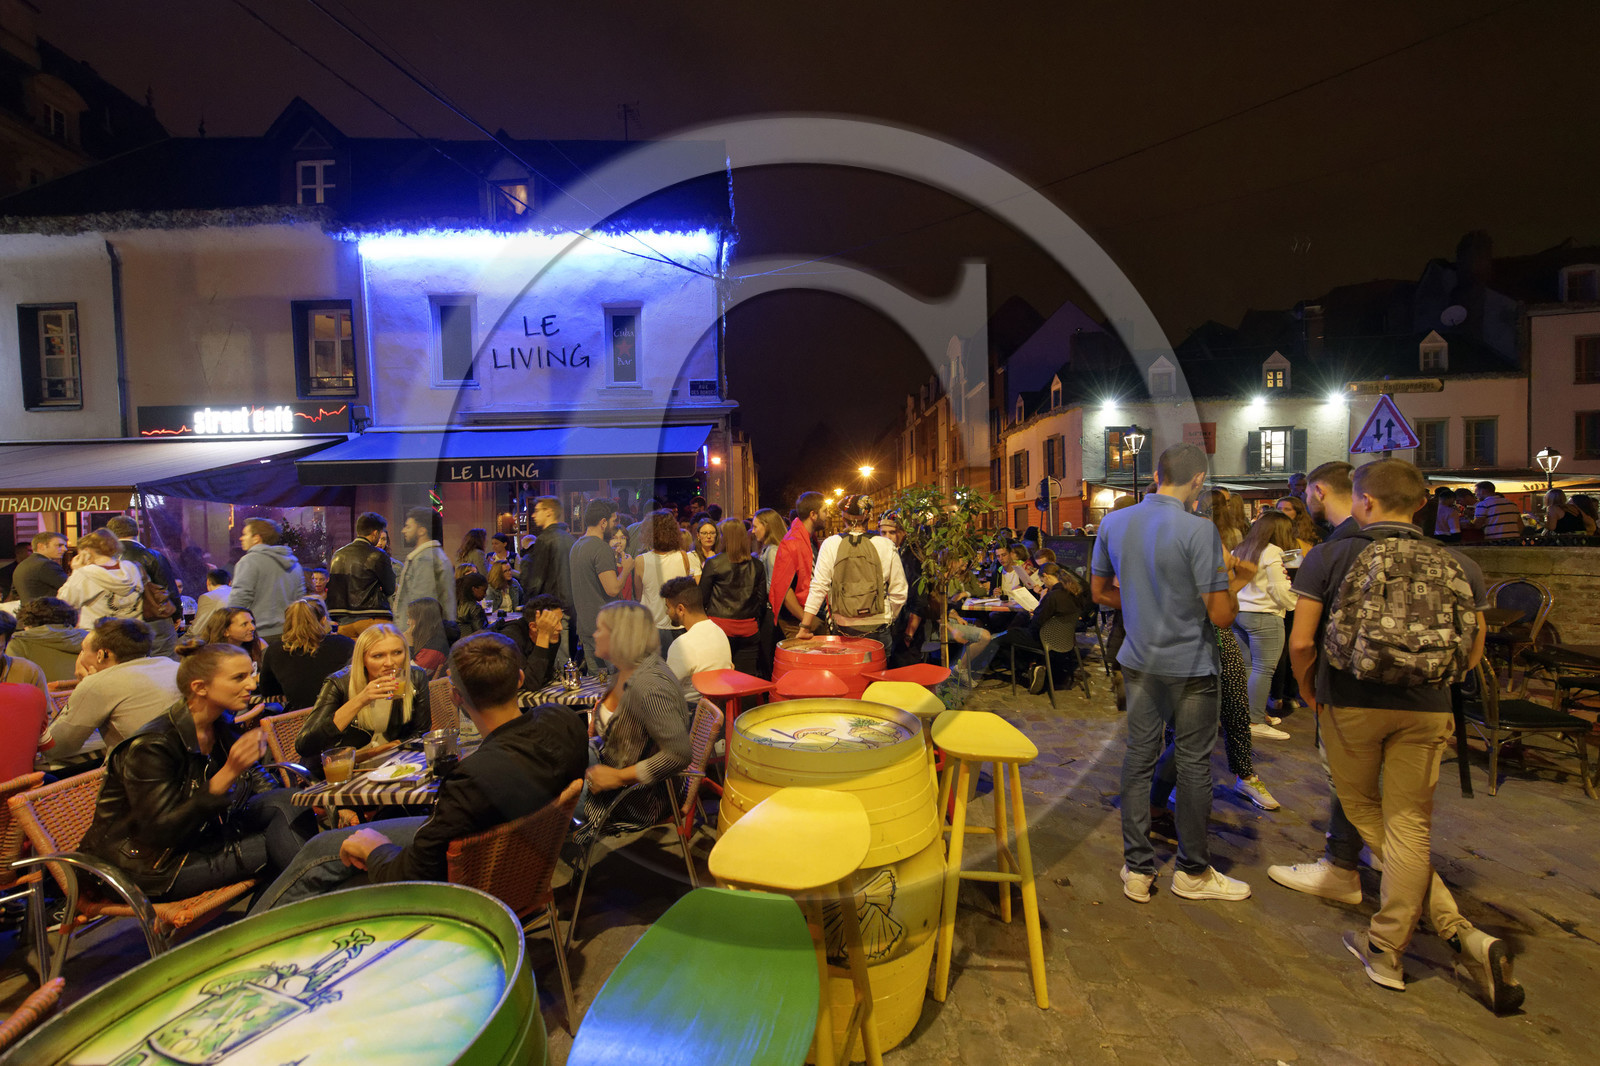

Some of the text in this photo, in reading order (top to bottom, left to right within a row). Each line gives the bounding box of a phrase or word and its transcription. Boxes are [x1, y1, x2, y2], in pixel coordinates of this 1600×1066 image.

[523, 314, 560, 337] LE
[613, 327, 635, 338] Cuba
[492, 342, 590, 369] LIVING
[617, 356, 633, 366] Bar
[193, 405, 293, 434] street café
[451, 462, 539, 480] LE LIVING
[0, 495, 110, 512] TRADING BAR
